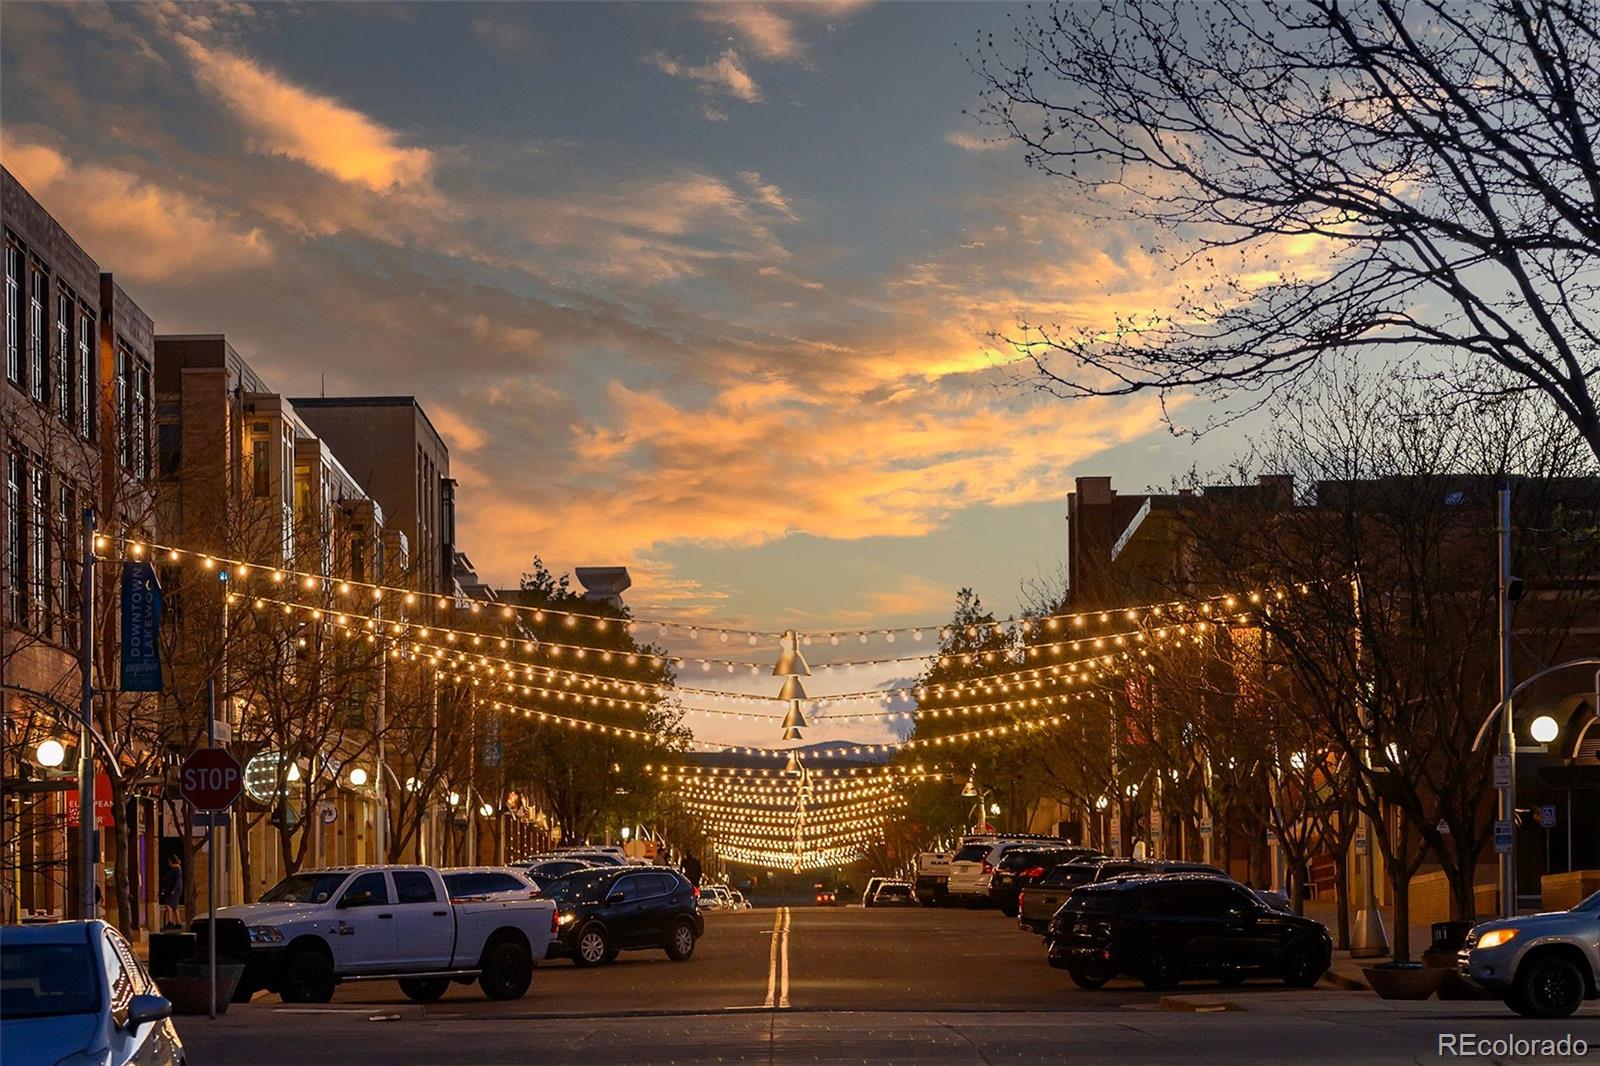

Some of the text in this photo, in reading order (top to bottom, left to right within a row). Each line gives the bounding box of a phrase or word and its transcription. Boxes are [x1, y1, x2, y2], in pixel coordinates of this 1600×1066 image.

[131, 566, 143, 658] DOWNTOWN
[184, 767, 238, 791] STOP
[69, 800, 114, 809] EUPEAN
